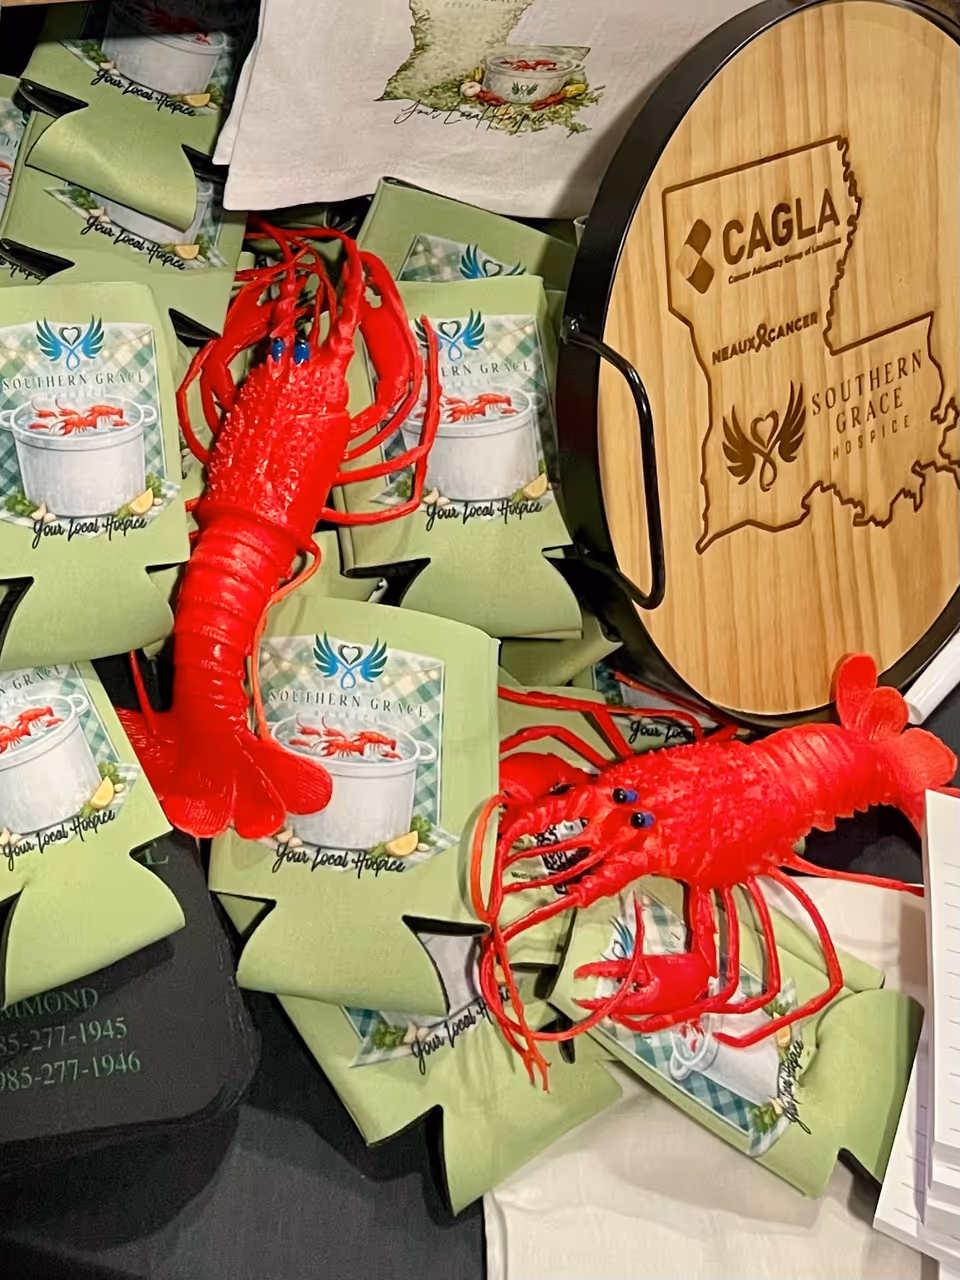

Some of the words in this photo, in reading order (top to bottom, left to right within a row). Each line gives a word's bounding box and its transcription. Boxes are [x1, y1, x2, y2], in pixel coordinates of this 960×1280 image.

[722, 188, 840, 265] CAGLA
[2, 373, 88, 390] SOUTHERN
[96, 371, 146, 384] GRACE
[811, 350, 923, 416] SOUTHERN
[836, 387, 904, 434] GRACE
[832, 415, 910, 460] HOSPICE
[12, 665, 63, 690] GRACE
[268, 690, 362, 707] SOUTHERN
[370, 698, 427, 719] GRACE
